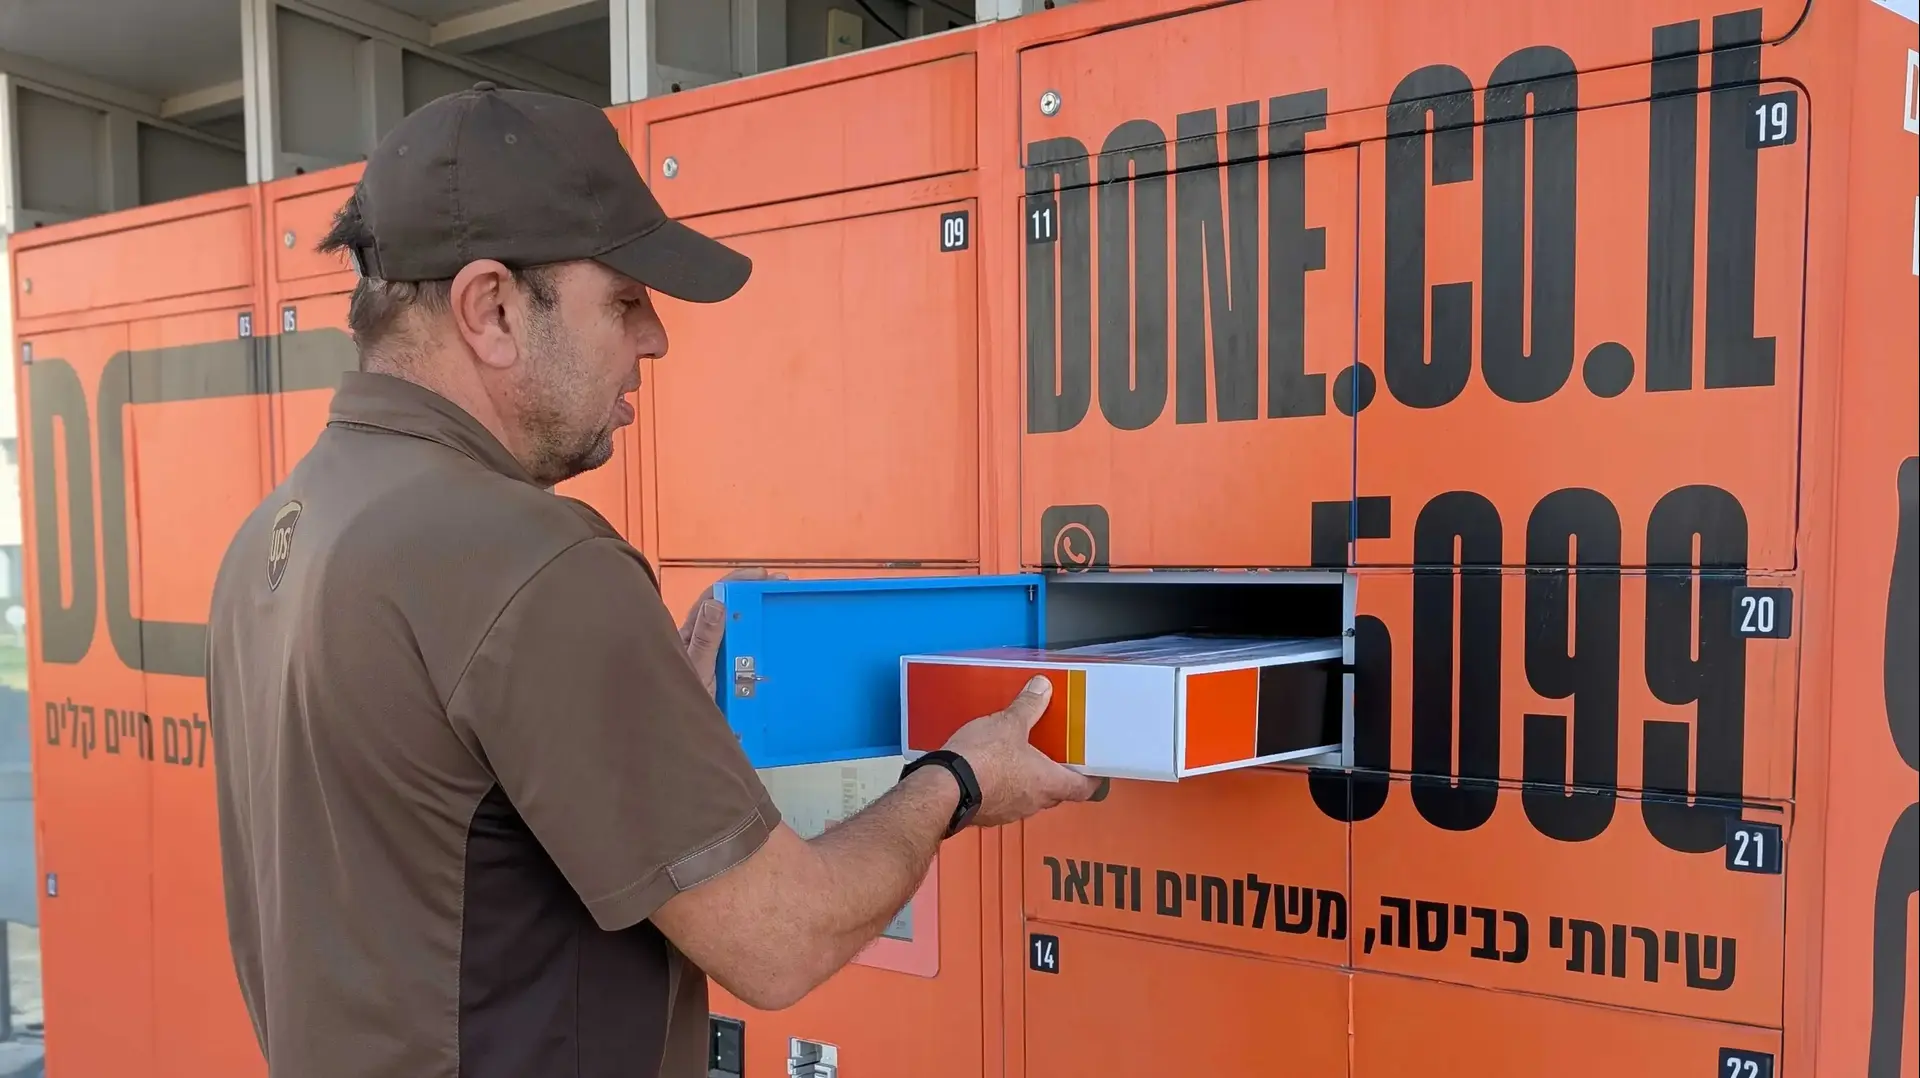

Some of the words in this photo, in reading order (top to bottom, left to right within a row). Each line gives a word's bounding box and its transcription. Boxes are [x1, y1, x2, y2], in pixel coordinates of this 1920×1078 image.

[1755, 102, 1788, 142] 19
[944, 217, 964, 247] 09
[1026, 8, 1776, 434] DONE.CO.IL
[1032, 208, 1050, 239] 11
[1740, 596, 1774, 632] 20
[45, 696, 96, 760] קלים
[104, 708, 154, 761] חיים
[162, 712, 207, 768] לכם
[1733, 830, 1764, 868] 21
[1043, 855, 1142, 913] ודואר
[1156, 869, 1348, 941] משלוחים
[1034, 939, 1055, 969] 14
[1363, 895, 1530, 964] כביסה,
[1548, 916, 1737, 991] שירותי
